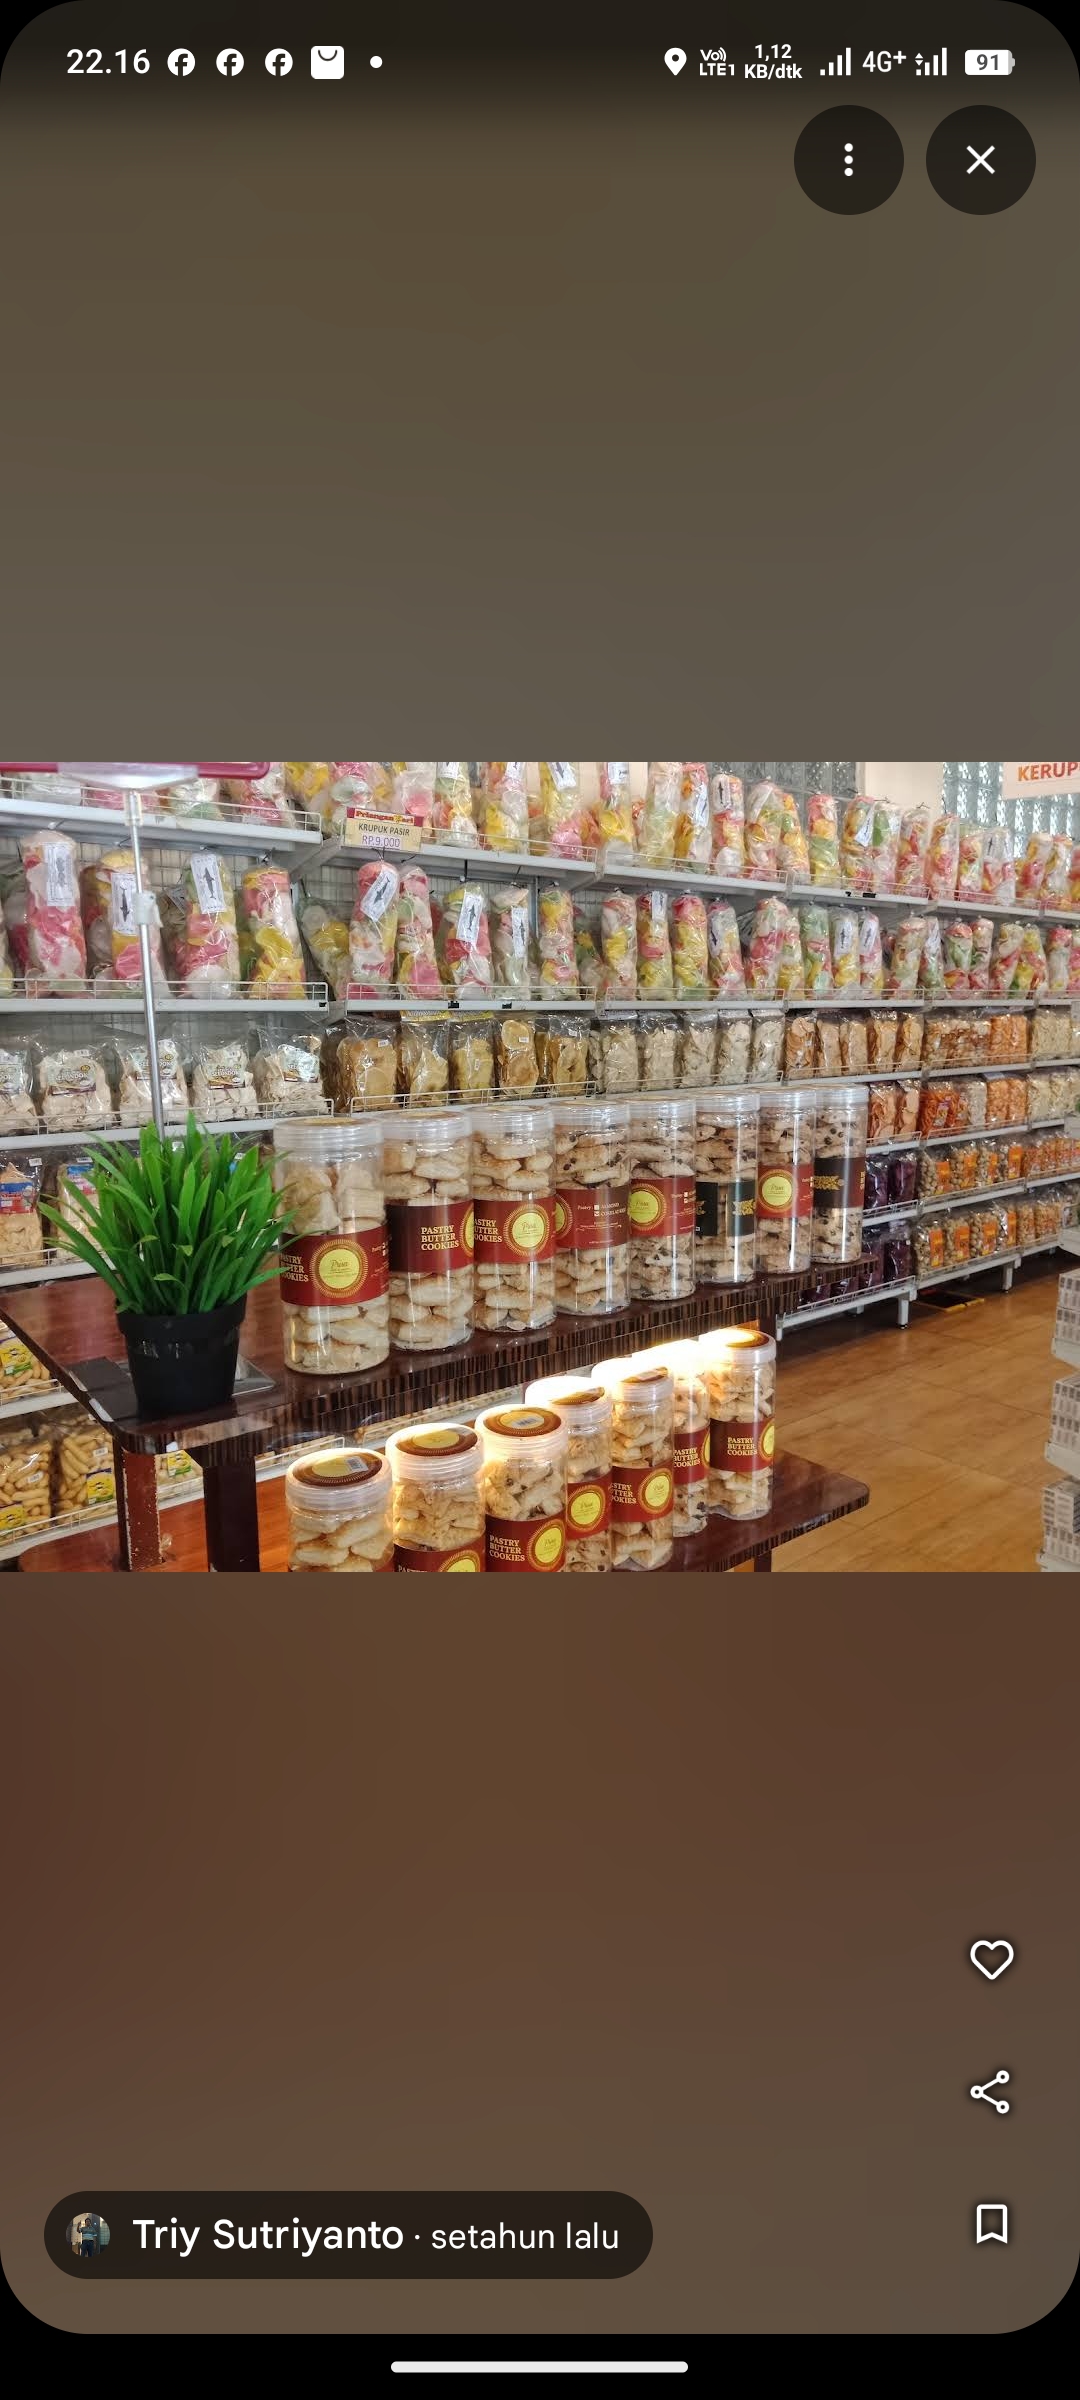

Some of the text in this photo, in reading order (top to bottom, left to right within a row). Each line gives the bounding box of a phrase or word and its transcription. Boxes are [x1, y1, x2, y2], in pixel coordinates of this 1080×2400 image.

[1018, 763, 1080, 781] KERUP
[358, 823, 410, 836] KRUPUK PASIR
[362, 835, 400, 848] RP.9.000
[474, 1219, 497, 1227] ASTRY
[421, 1225, 455, 1235] PASTRY
[474, 1226, 499, 1235] UTTER
[421, 1233, 456, 1243] BUTTER
[474, 1233, 503, 1243] OOKIES
[421, 1240, 460, 1251] COOKIES
[281, 1254, 302, 1265] ASTRY
[281, 1261, 305, 1274] TER
[281, 1271, 309, 1283] OKIES
[610, 1489, 634, 1498] TTER
[610, 1495, 637, 1504] OKIES
[490, 1535, 519, 1547] PASTRY
[490, 1543, 521, 1554] BUTTER
[490, 1550, 525, 1562] COOKIES
